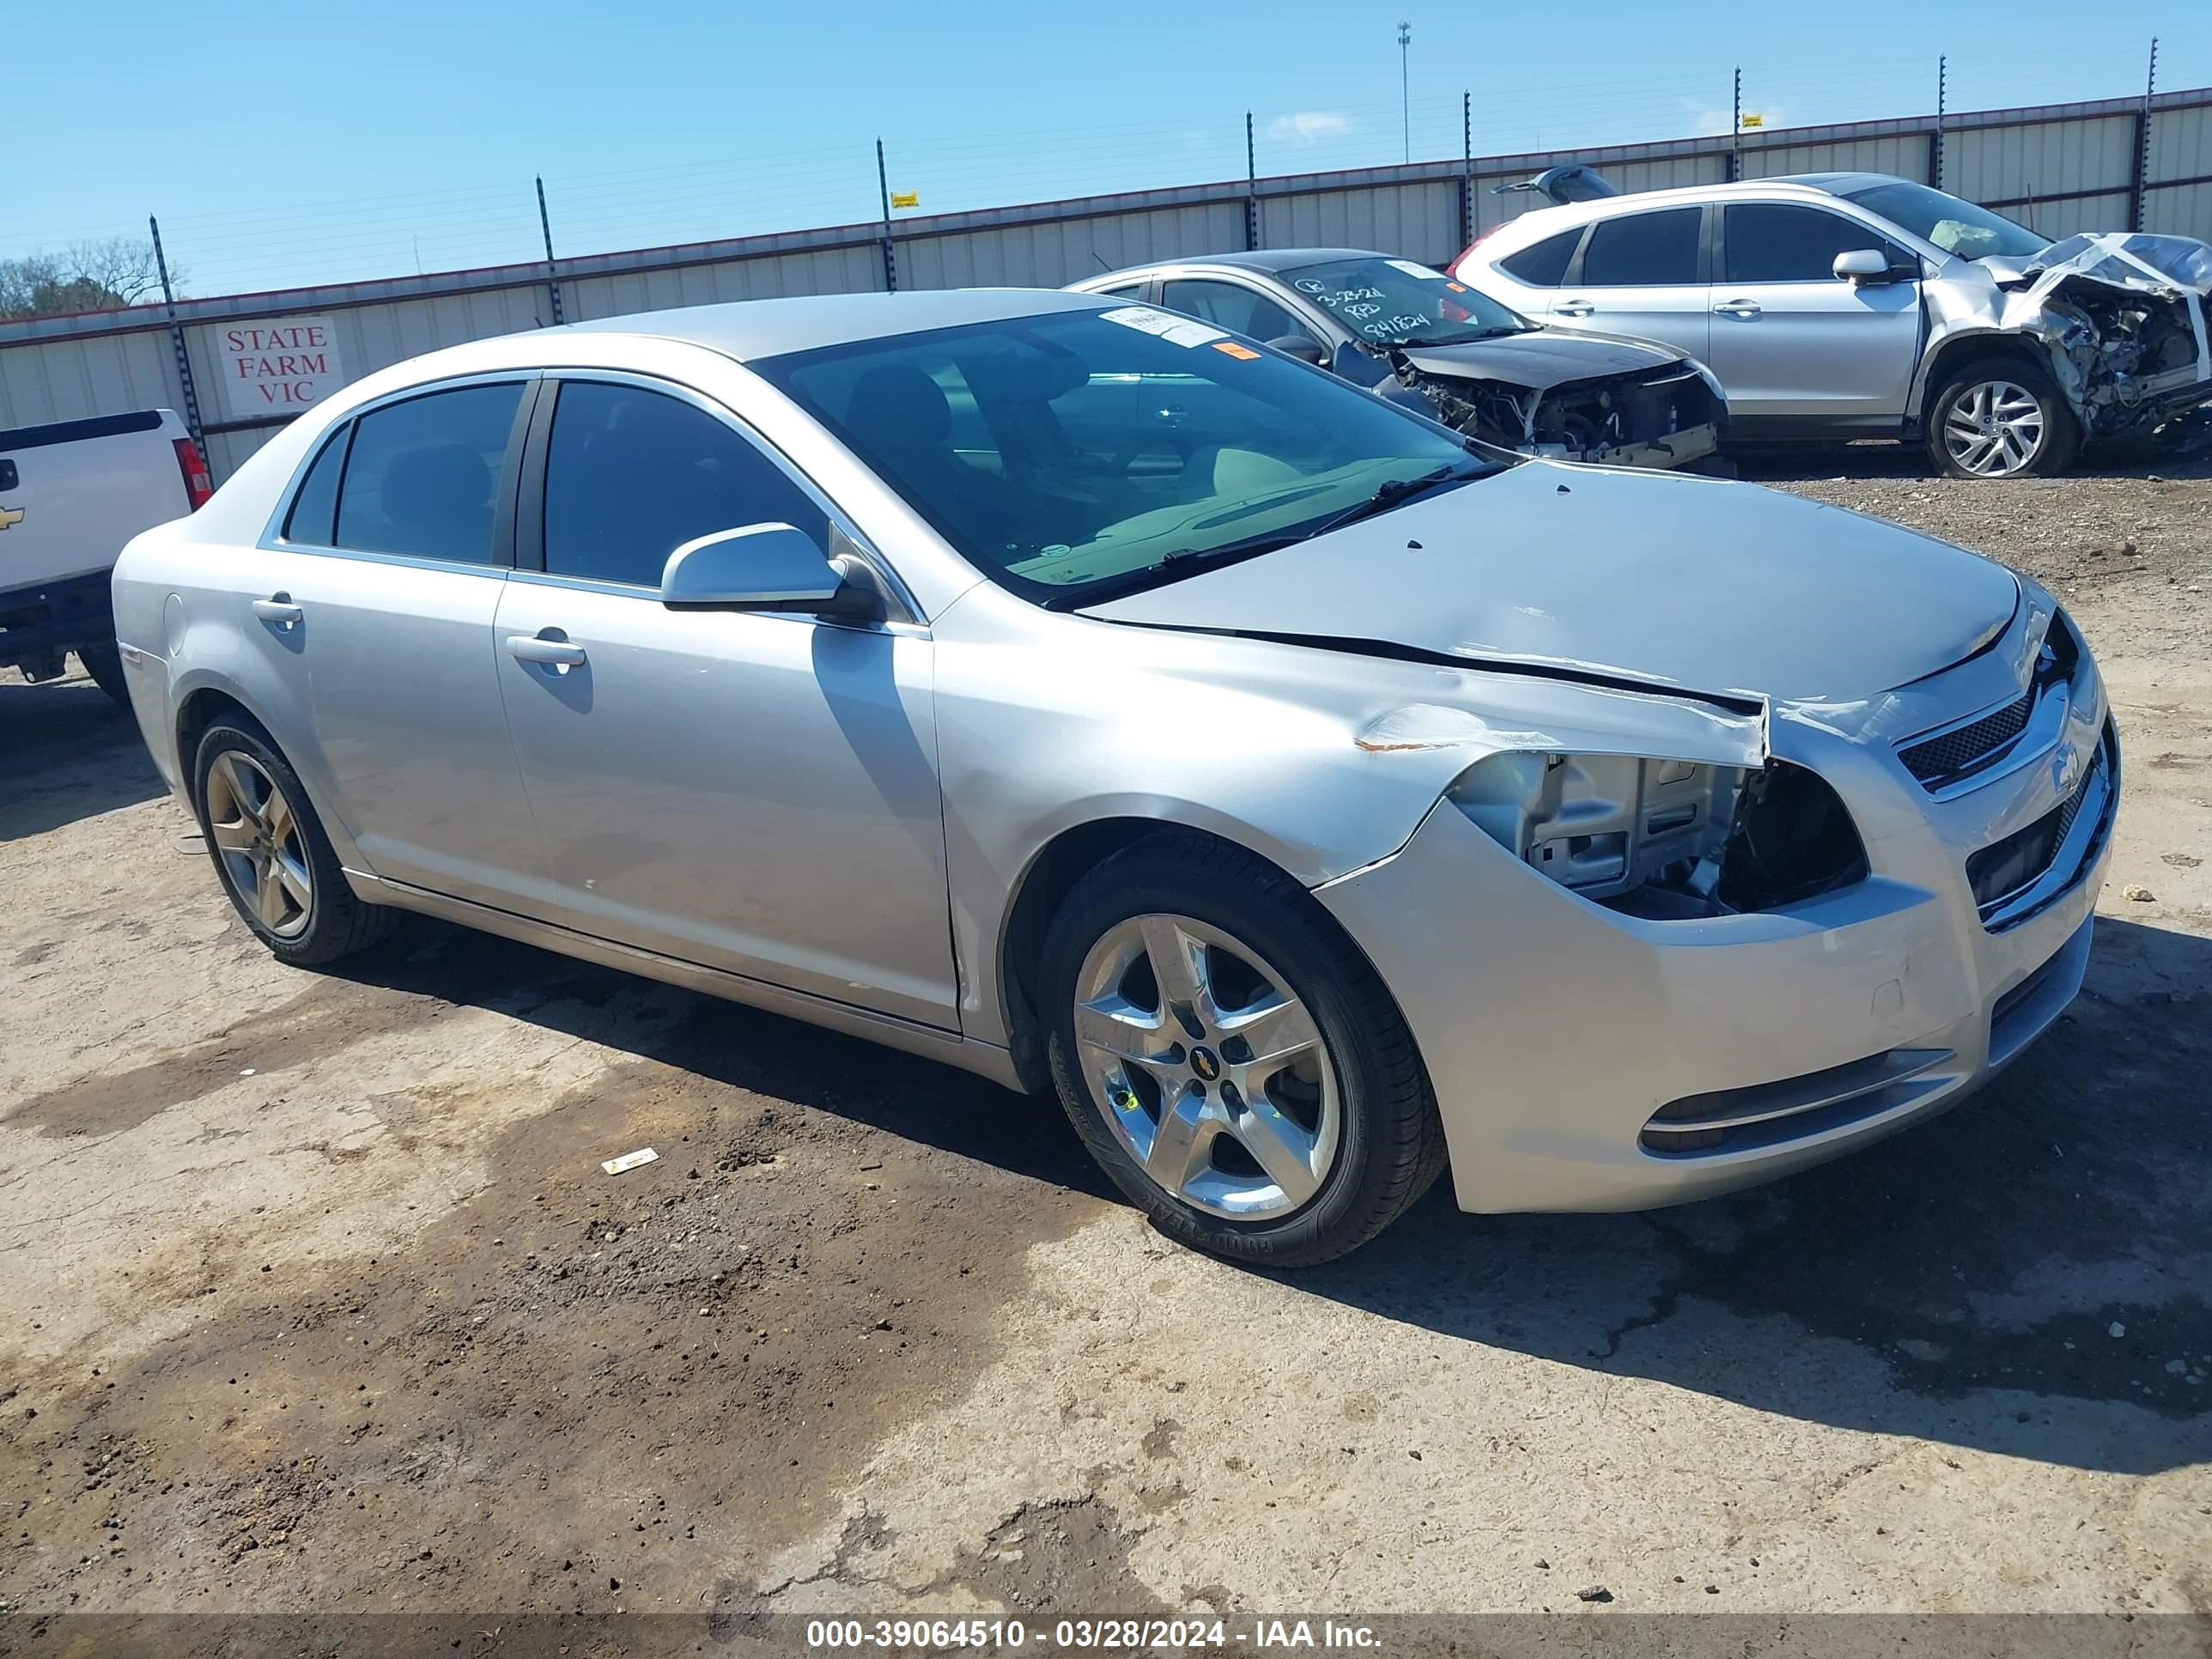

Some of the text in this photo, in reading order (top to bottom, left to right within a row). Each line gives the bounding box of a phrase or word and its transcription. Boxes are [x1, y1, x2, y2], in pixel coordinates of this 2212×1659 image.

[1364, 313, 1431, 338] 841824
[227, 326, 327, 352] STATE
[236, 354, 329, 379] FARM
[258, 380, 316, 404] VIC
